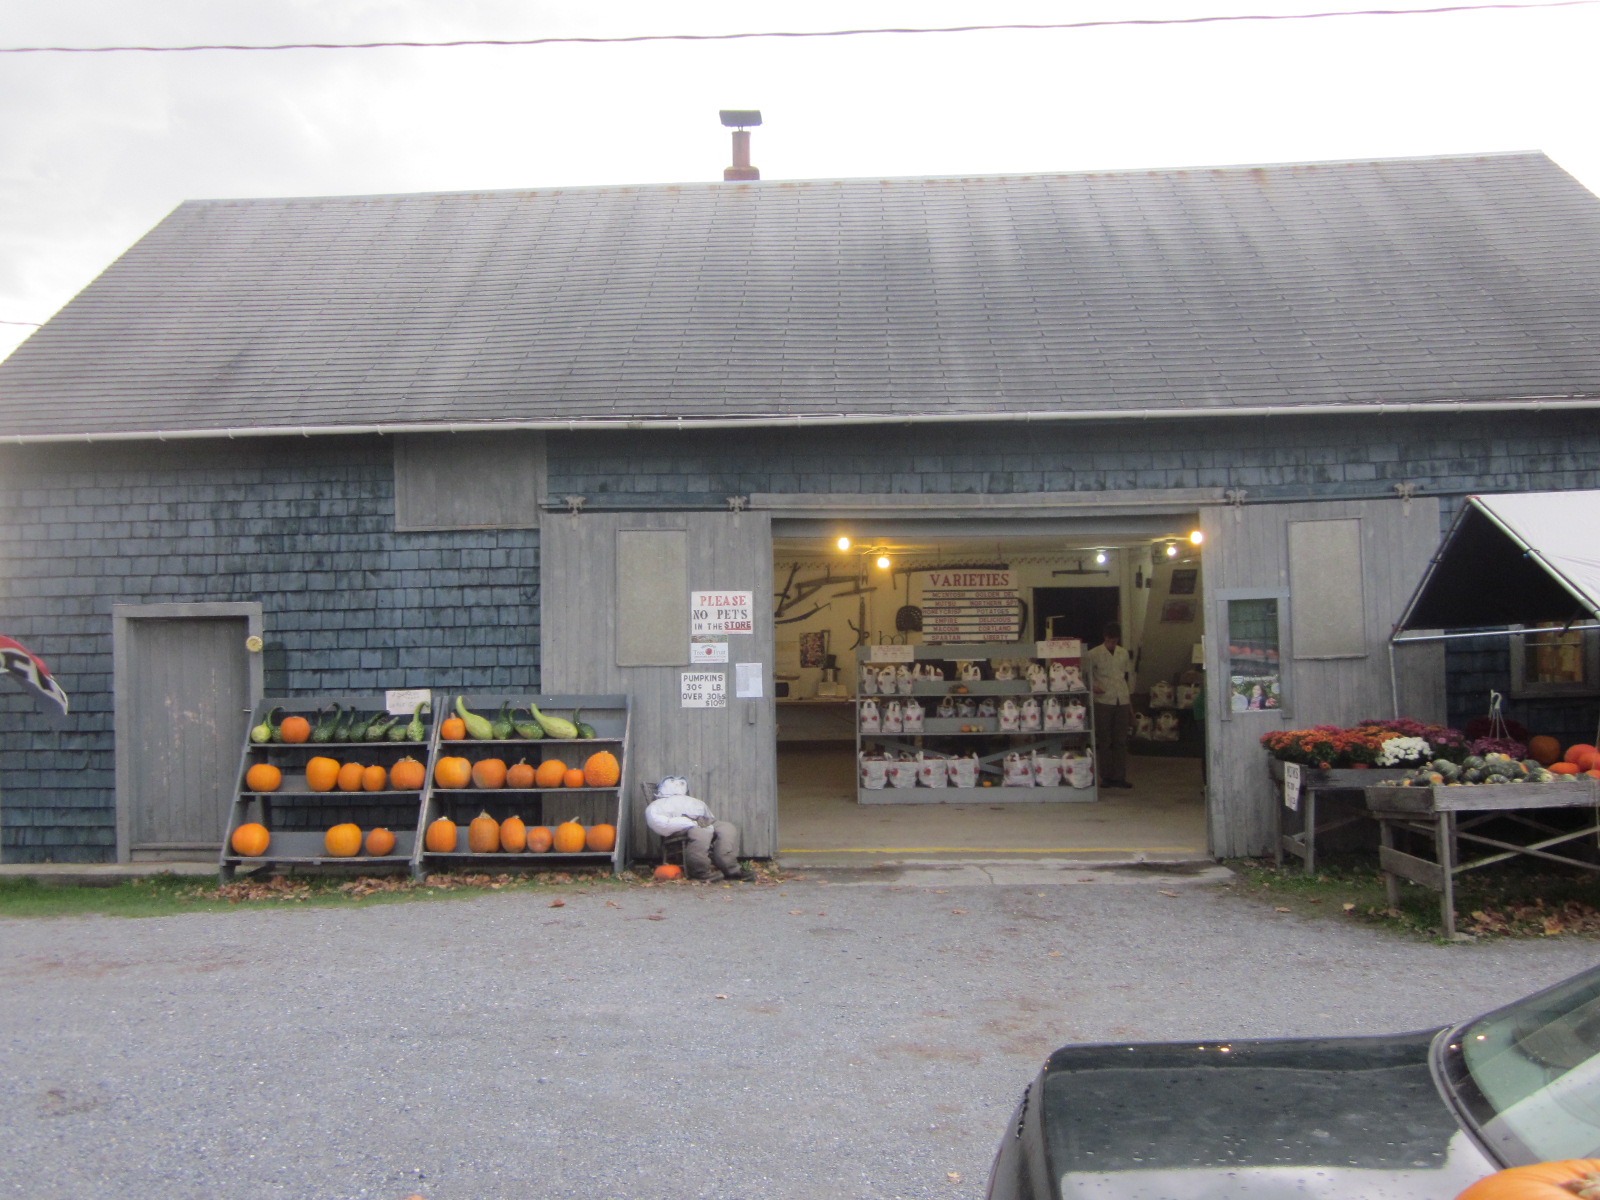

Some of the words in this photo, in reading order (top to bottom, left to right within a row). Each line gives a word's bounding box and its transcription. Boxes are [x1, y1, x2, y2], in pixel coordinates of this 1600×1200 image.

[930, 573, 1009, 587] VARIETIES
[700, 595, 746, 606] PLEASE
[693, 609, 708, 620] NO
[717, 609, 748, 620] PETS
[694, 622, 703, 630] IN
[707, 622, 723, 630] THE
[724, 620, 752, 629] STORE
[683, 674, 723, 682] PUMPKINS
[686, 683, 703, 691] 30¢
[682, 692, 703, 700] OVER
